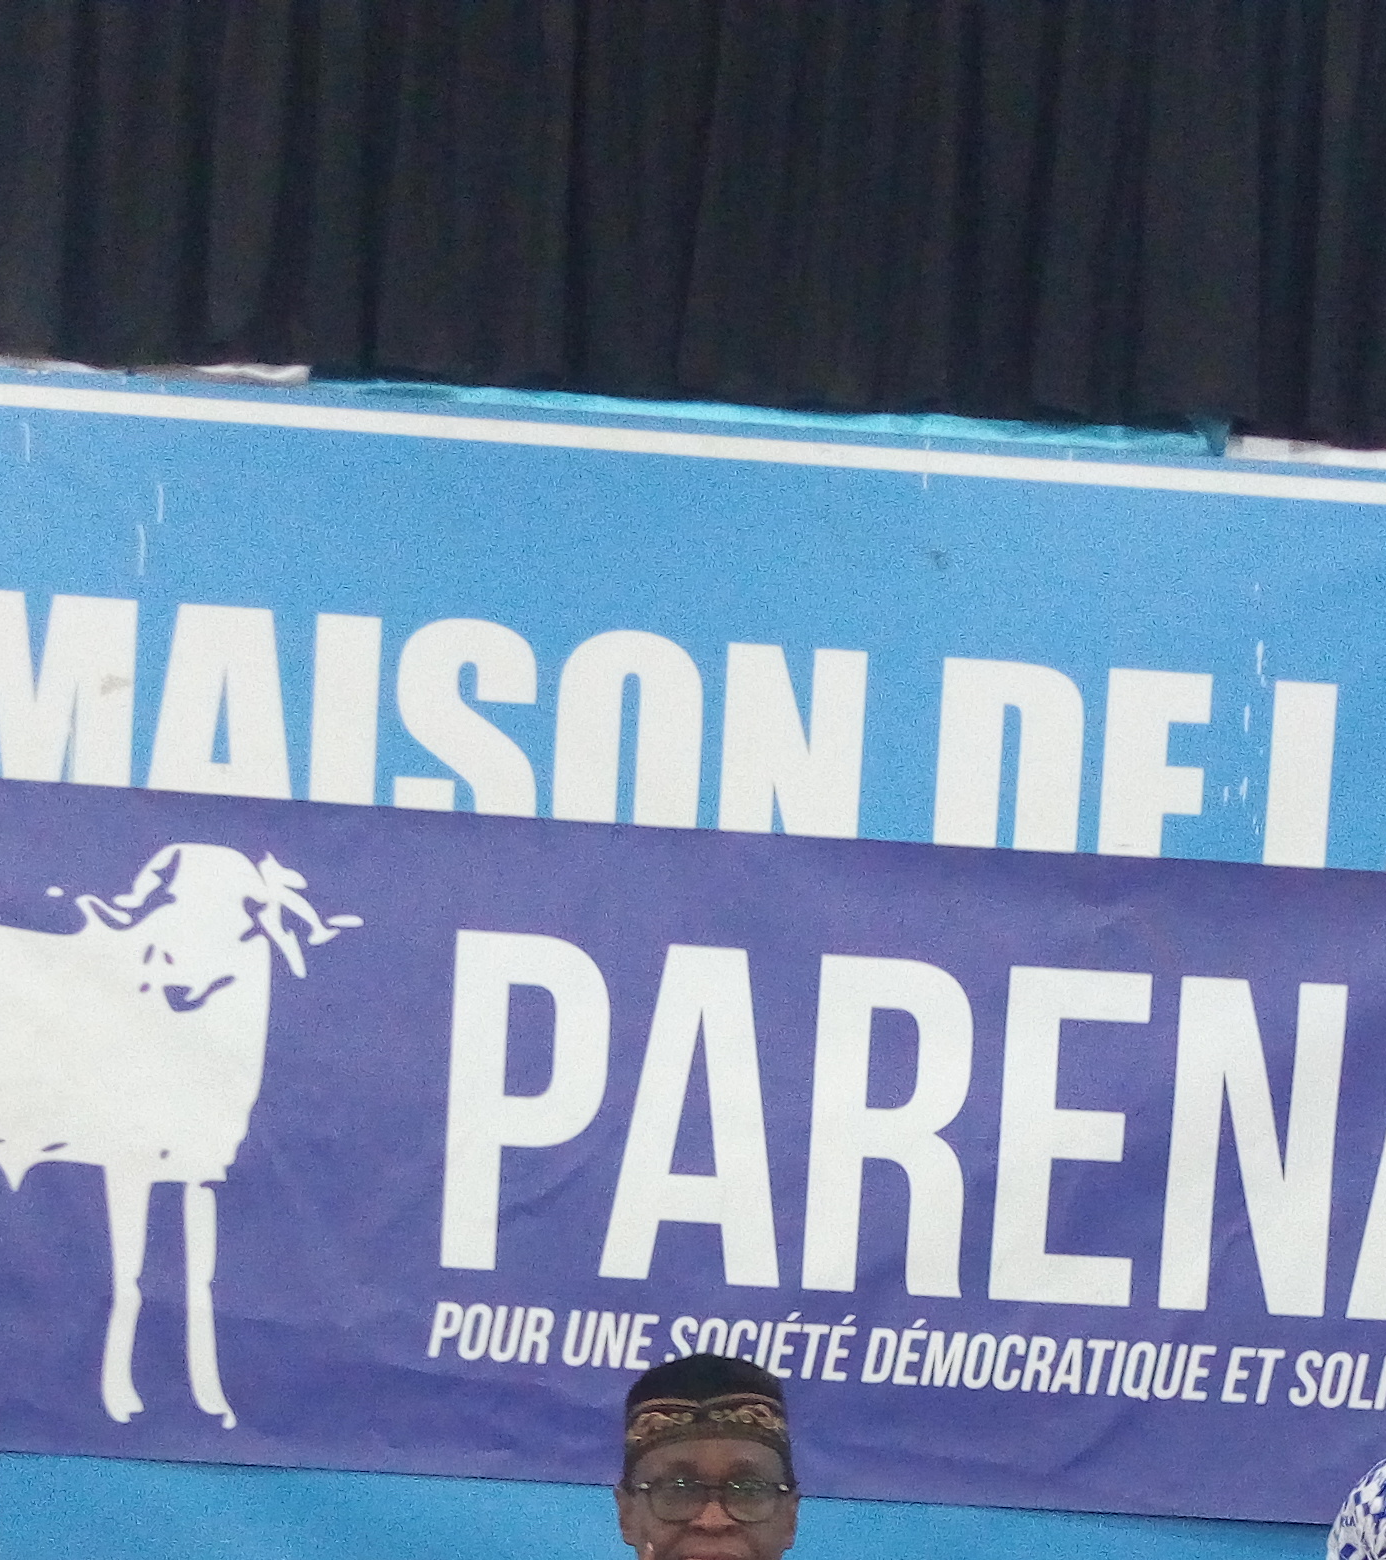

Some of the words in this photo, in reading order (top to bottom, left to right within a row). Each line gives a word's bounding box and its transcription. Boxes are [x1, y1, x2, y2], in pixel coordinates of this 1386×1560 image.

[932, 656, 1213, 858] DE
[427, 1300, 555, 1364] POUR
[562, 1309, 660, 1371] UNE
[665, 1311, 857, 1382] SOCIÉTÉ
[860, 1318, 1217, 1402] DÉMOCRATIQUE
[1220, 1346, 1285, 1404] ET
